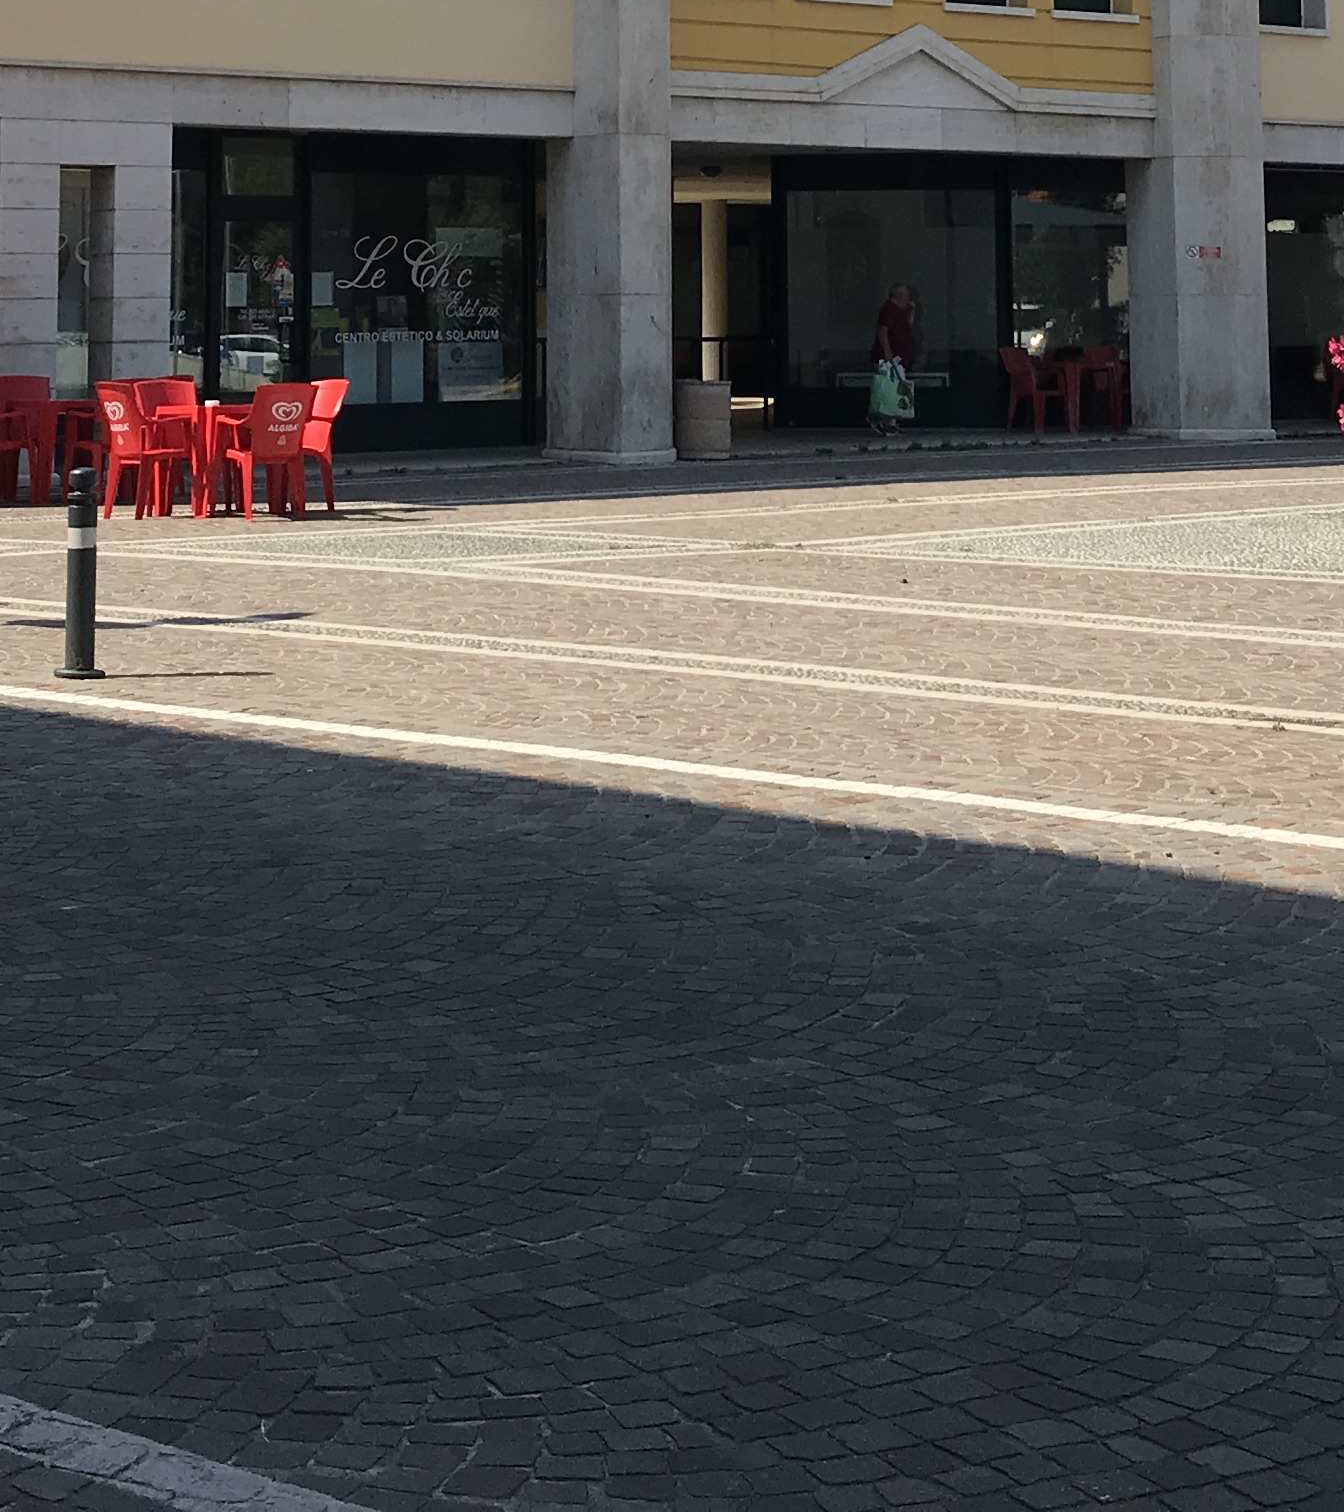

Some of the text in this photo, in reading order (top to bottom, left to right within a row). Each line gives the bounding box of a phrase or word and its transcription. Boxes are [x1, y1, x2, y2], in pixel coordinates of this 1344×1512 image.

[335, 235, 398, 289] Le
[334, 328, 499, 344] CENTRO ESTETICO & SOLARIUM
[267, 423, 299, 433] ALGIDA
